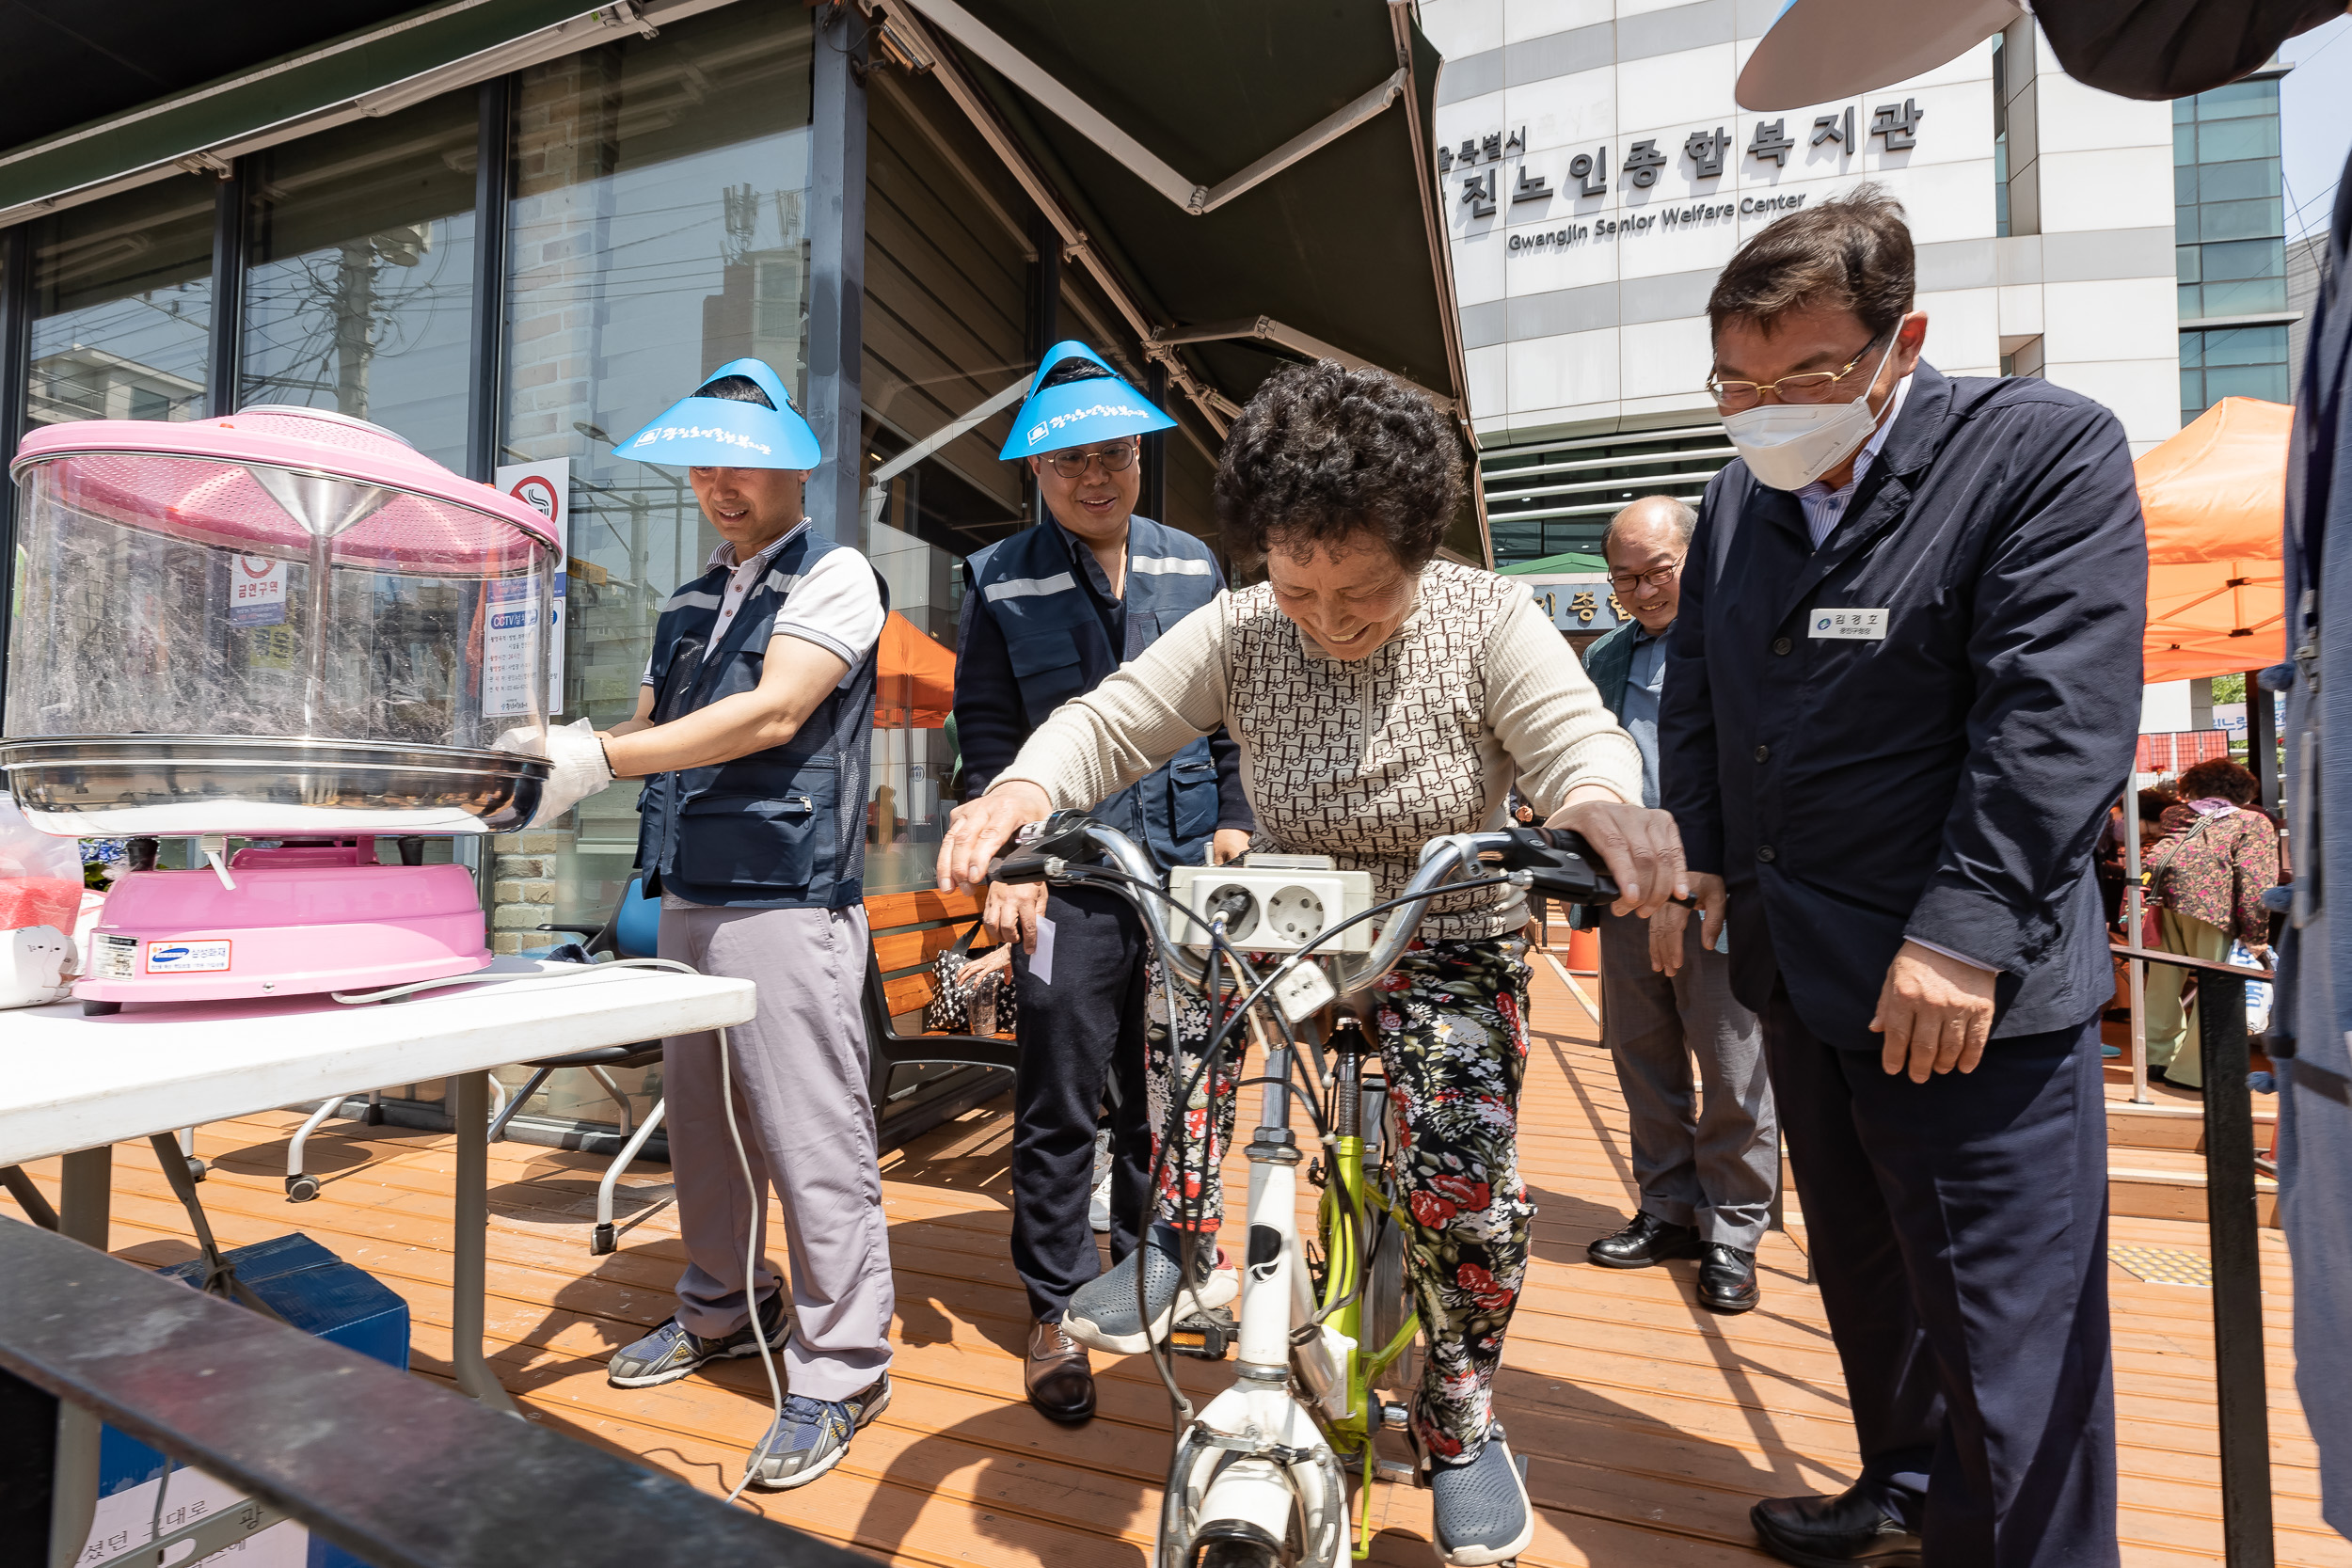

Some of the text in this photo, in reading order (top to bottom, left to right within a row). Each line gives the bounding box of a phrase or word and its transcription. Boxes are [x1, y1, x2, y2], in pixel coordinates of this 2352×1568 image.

[1443, 98, 1925, 219] 진노인종합복지관
[1508, 191, 1807, 251] Gwangjin Senior Welfare Center
[238, 580, 278, 599] 금연구역
[239, 1505, 264, 1530] 광
